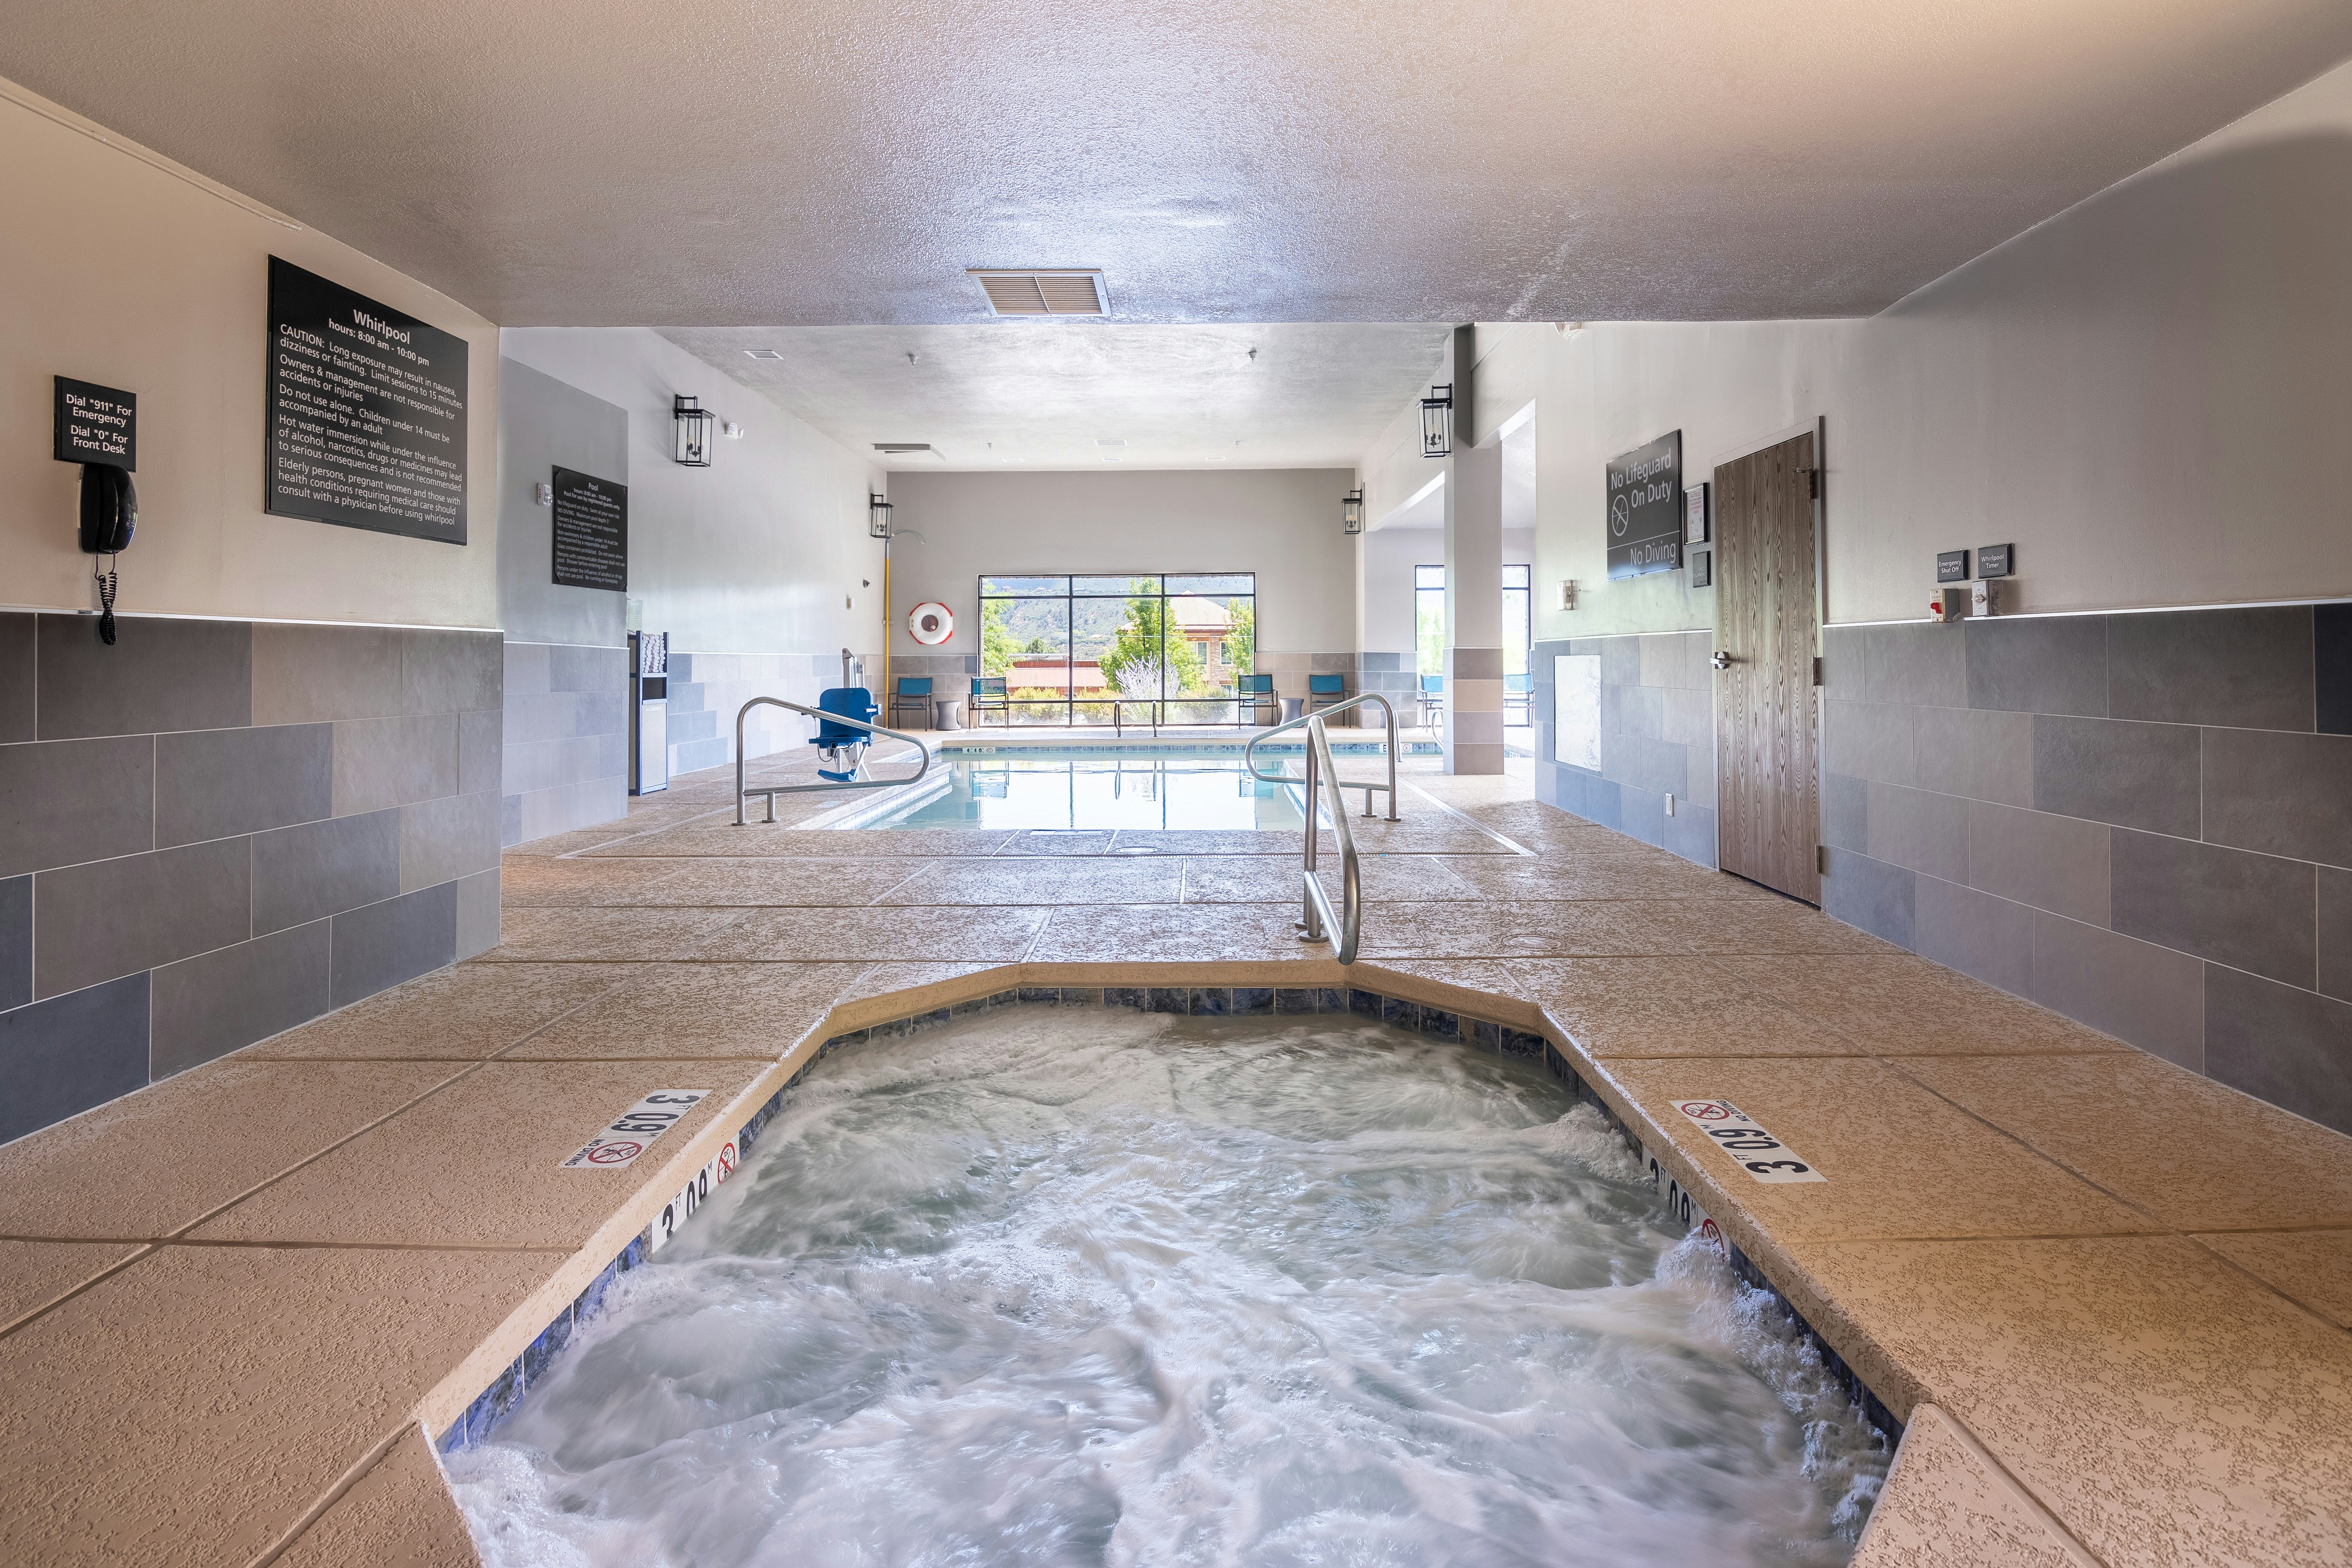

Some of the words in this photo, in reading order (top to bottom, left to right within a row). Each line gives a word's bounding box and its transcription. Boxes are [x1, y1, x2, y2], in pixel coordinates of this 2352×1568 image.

[329, 318, 356, 338] hours:
[358, 331, 375, 344] 8:00
[377, 340, 389, 351] am
[397, 346, 416, 361] 10:00
[418, 356, 429, 366] pm
[353, 309, 410, 344] Whirlpool
[280, 324, 324, 348] CAUTION:
[329, 341, 349, 359] Long
[351, 352, 386, 370] exposure
[388, 365, 402, 378] may
[405, 372, 424, 384] result
[425, 377, 431, 387] in
[433, 382, 456, 397] nausea,
[280, 337, 319, 358] dizziness
[322, 354, 331, 362] or
[333, 355, 367, 376] fainting.
[371, 369, 390, 383] Limit
[391, 378, 418, 393] sessions
[419, 387, 427, 396] to
[429, 390, 437, 399] 15
[438, 395, 462, 409] minutes
[280, 369, 321, 388] accidents
[323, 382, 332, 391] or
[335, 383, 363, 402] injuries
[280, 354, 314, 373] Owners
[317, 366, 323, 376] &
[325, 371, 378, 395] management
[380, 389, 392, 399] are
[393, 394, 406, 404] not
[408, 398, 444, 417] responsible
[446, 410, 455, 420] for
[67, 394, 86, 406] Dial
[90, 399, 113, 411] "911"
[117, 405, 132, 416] For
[73, 407, 126, 427] Emergency
[279, 399, 337, 421] accompanied
[339, 413, 349, 427] by
[351, 420, 360, 428] an
[363, 422, 382, 435] adult
[280, 383, 293, 396] Do
[296, 390, 311, 402] not
[313, 396, 327, 406] use
[329, 399, 354, 414] alone.
[359, 408, 390, 425] Children
[392, 420, 413, 432] under
[415, 425, 423, 435] 14
[424, 430, 440, 440] must
[442, 433, 449, 443] be
[71, 425, 89, 437] Dial
[94, 430, 109, 439] "0"
[113, 433, 128, 443] For
[73, 437, 99, 449] Front
[103, 442, 125, 454] Desk
[279, 414, 296, 427] Hot
[298, 421, 324, 434] water
[327, 426, 368, 446] immersion
[370, 440, 390, 452] while
[392, 446, 413, 458] under
[414, 451, 426, 461] the
[427, 454, 456, 469] influence
[278, 440, 289, 450] to
[291, 445, 322, 459] serious
[324, 453, 378, 472] consequences
[380, 466, 393, 475] and
[396, 468, 401, 477] is
[403, 472, 414, 481] not
[417, 475, 461, 491] recommended
[279, 428, 289, 438] of
[291, 430, 325, 448] alcohol,
[328, 441, 365, 458] narcotics,
[367, 449, 389, 464] drugs
[400, 460, 433, 474] medicines
[434, 469, 448, 479] may
[449, 470, 462, 481] lead
[1611, 472, 1623, 490] No
[1626, 447, 1671, 485] Lifeguard
[589, 483, 598, 491] Pool
[1631, 489, 1644, 508] On
[1648, 481, 1672, 503] Duty
[1630, 548, 1642, 566] No
[1646, 541, 1676, 563] Diving
[1981, 553, 2004, 562] Whirlpool
[646, 1094, 699, 1104] 3
[1716, 1100, 1742, 1114] DIVING
[564, 1148, 595, 1166] DIVING
[1745, 1160, 1809, 1173] 3
[676, 1192, 681, 1211] FT
[708, 1160, 712, 1174] M
[1660, 1166, 1666, 1183] FT
[1692, 1199, 1696, 1215] M
